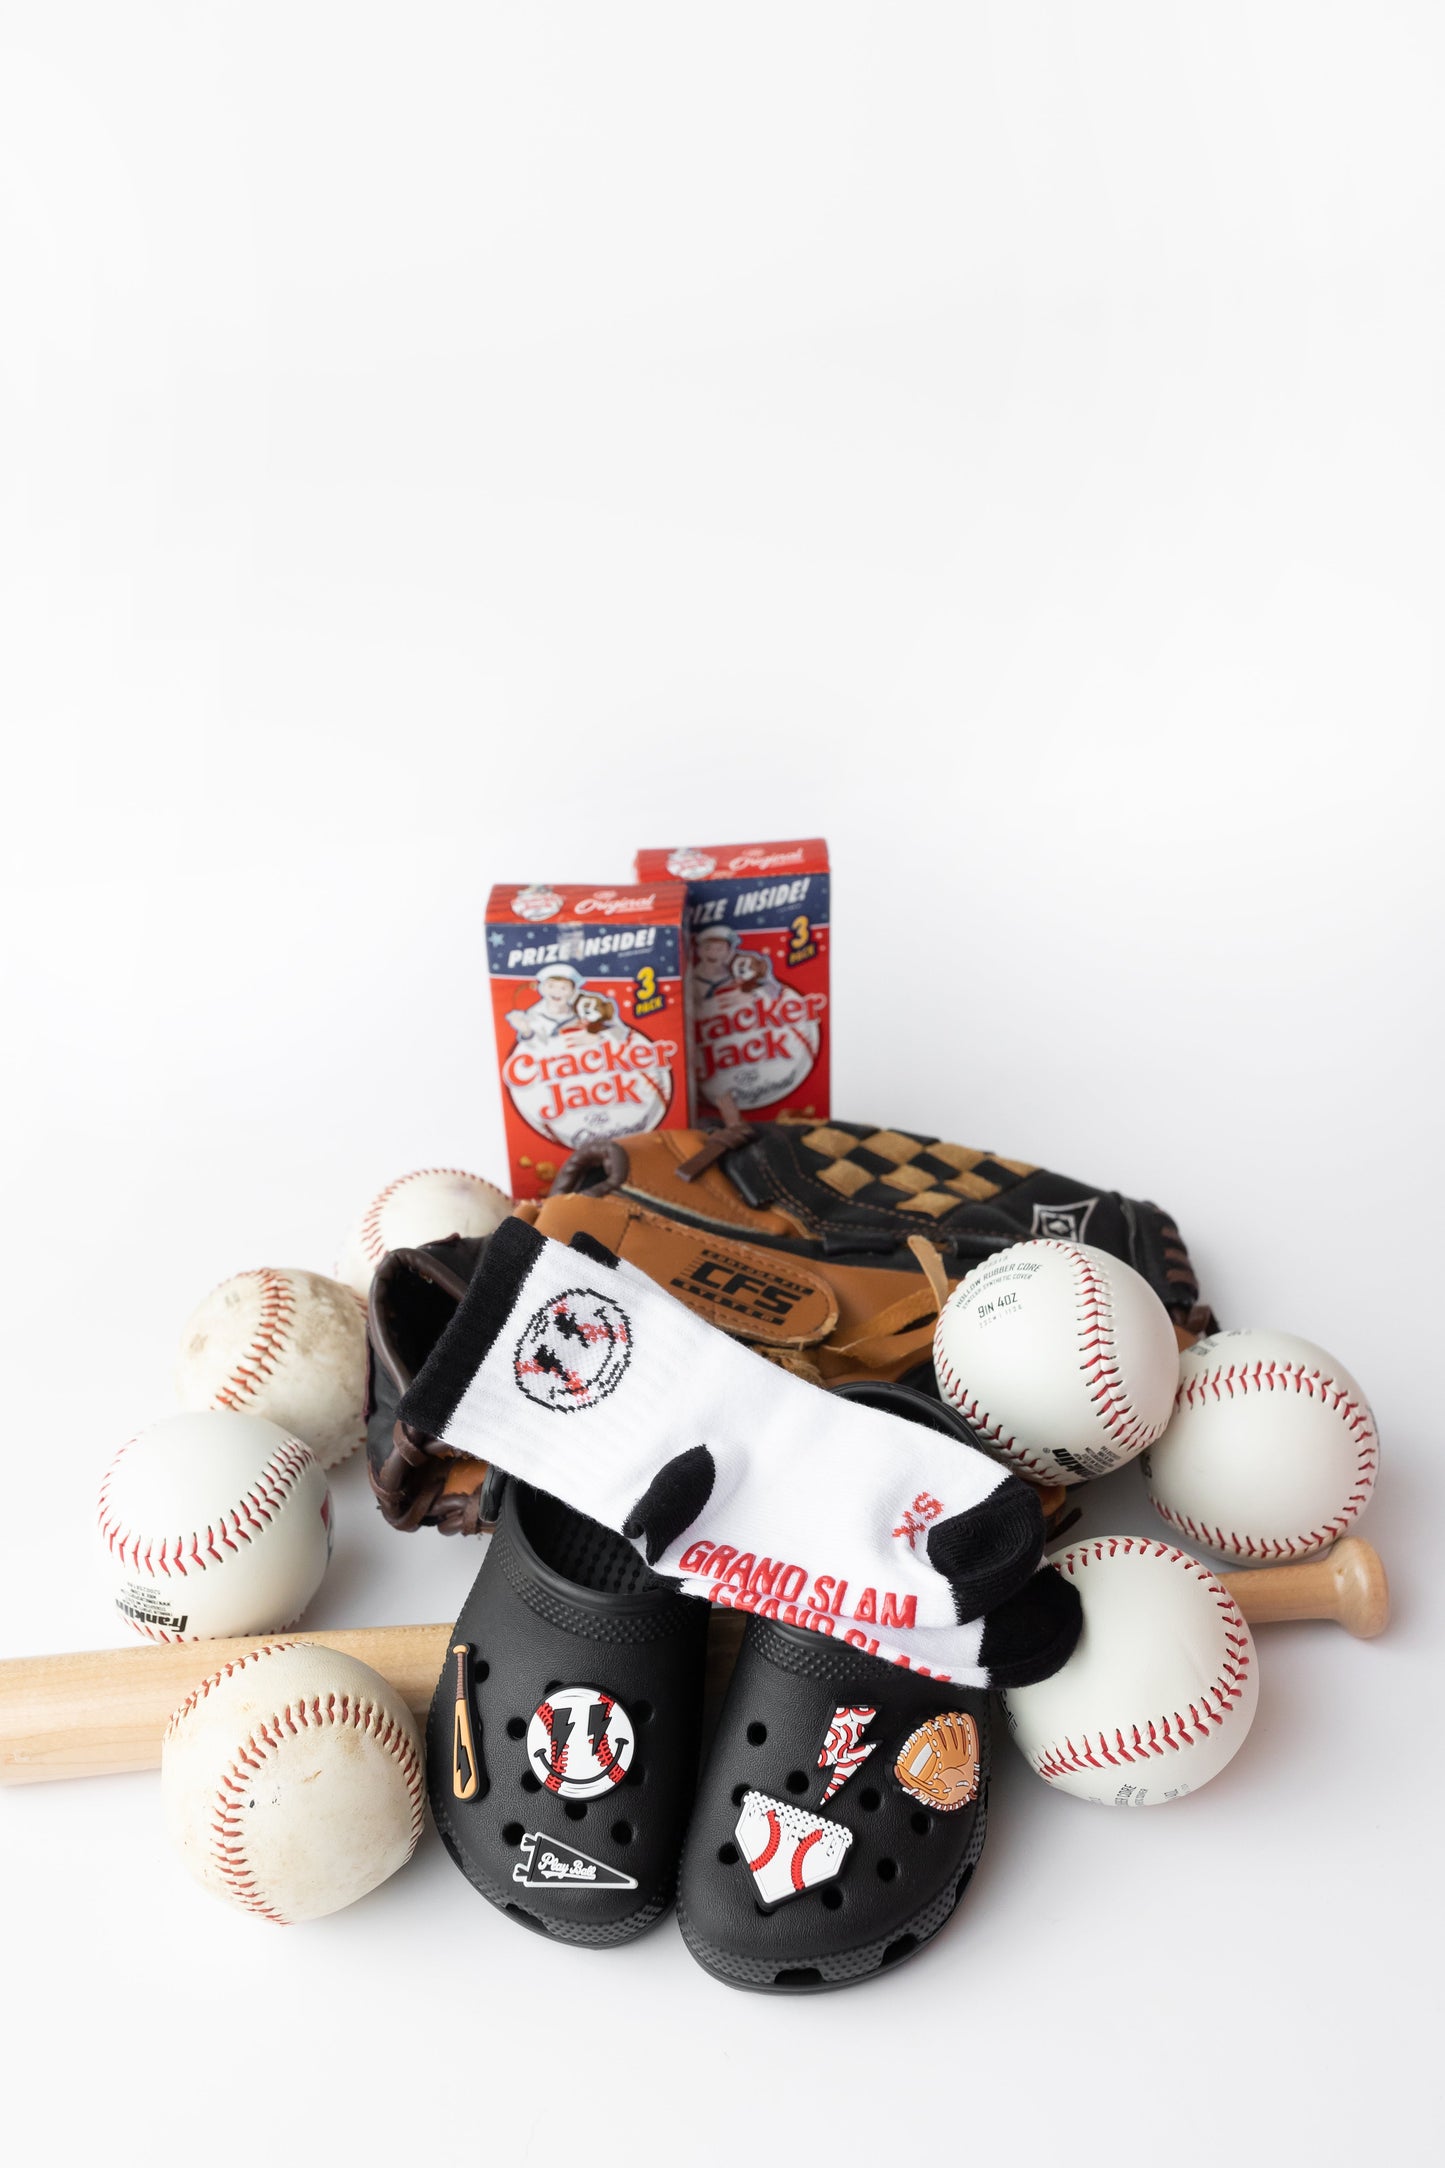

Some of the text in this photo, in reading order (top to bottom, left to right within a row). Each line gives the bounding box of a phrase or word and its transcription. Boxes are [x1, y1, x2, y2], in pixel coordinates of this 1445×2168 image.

[728, 848, 804, 871] Original
[574, 893, 657, 916] Original
[732, 876, 811, 917] INSIDE!
[507, 926, 657, 969] PRIZE INSIDE!
[790, 915, 809, 949] 3
[636, 966, 656, 1001] 3
[694, 995, 825, 1044] racker
[506, 1038, 677, 1087] Cracker
[696, 1029, 792, 1081] Jack
[539, 1073, 643, 1120] Jack
[690, 1260, 802, 1315] CFS
[955, 1277, 982, 1308] HOLLOW
[982, 1263, 1016, 1282] RUBBER
[1016, 1261, 1043, 1273] CORE
[977, 1301, 995, 1319] 9IN
[892, 1491, 945, 1550] XS
[678, 1540, 918, 1629] GRAND SLAM
[537, 1852, 597, 1876] Play Ball
